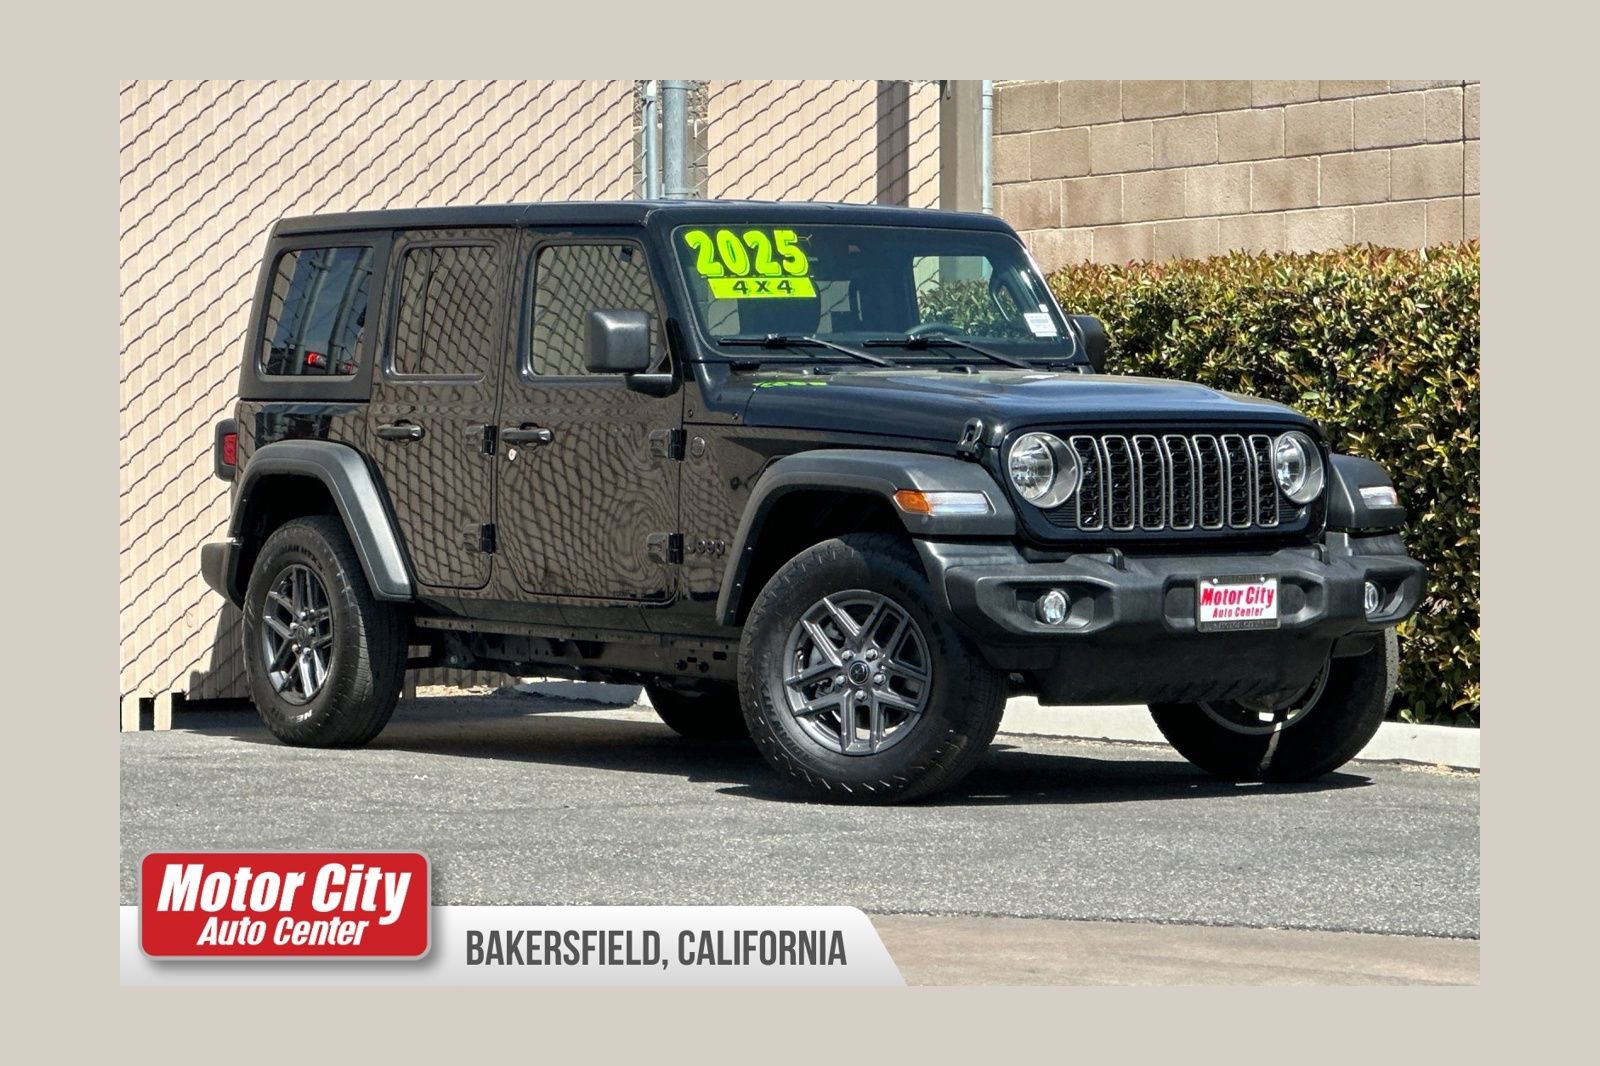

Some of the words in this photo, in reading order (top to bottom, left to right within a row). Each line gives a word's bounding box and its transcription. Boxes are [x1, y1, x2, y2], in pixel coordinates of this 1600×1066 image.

[684, 229, 809, 277] 2025
[1200, 587, 1244, 606] Motor
[1245, 586, 1275, 608] City
[1212, 607, 1233, 618] Auto
[1234, 606, 1264, 617] Center
